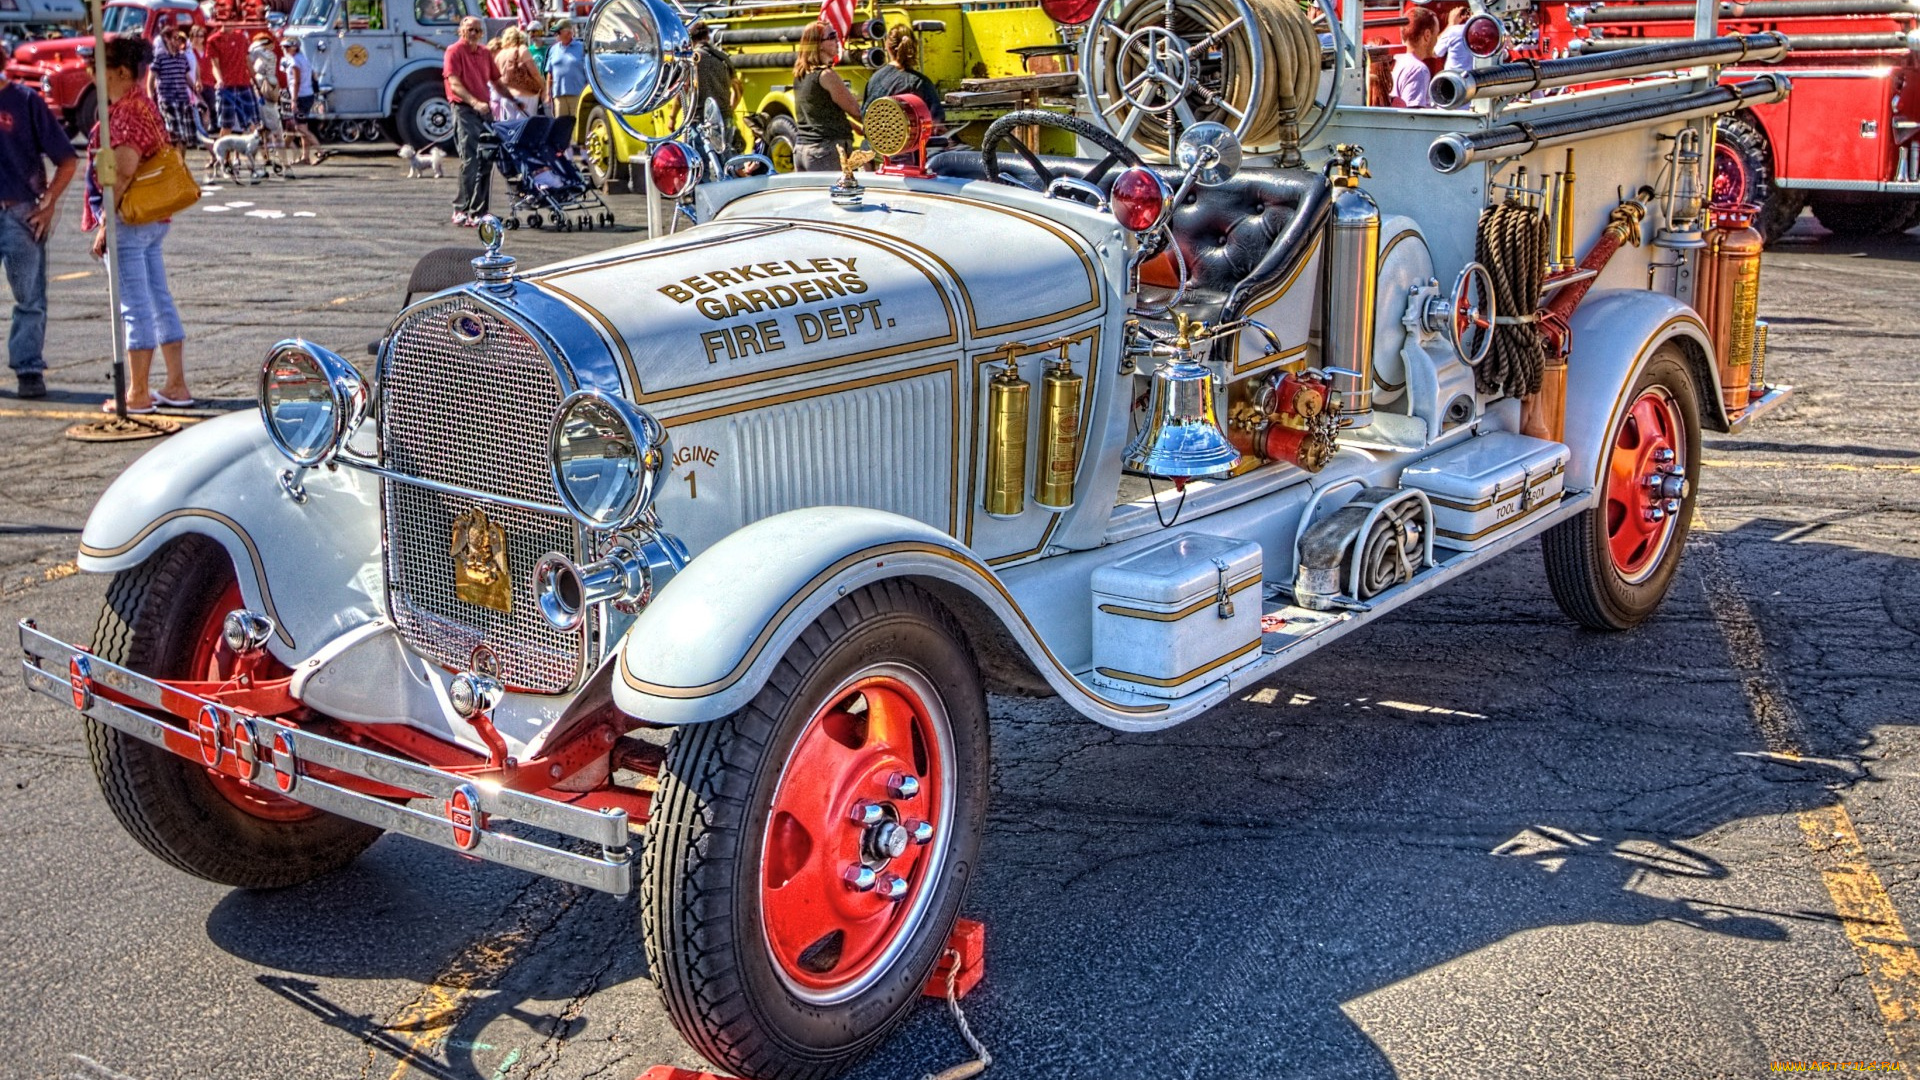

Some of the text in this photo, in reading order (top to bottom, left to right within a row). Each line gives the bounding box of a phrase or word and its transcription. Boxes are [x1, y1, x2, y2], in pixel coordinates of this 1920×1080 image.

[657, 258, 857, 303] BERKELEY
[695, 273, 868, 320] GARDENS
[700, 299, 896, 364] FIRE DEPT.
[671, 445, 719, 470] NGINE
[683, 470, 697, 499] 1
[1496, 502, 1515, 519] TOOL
